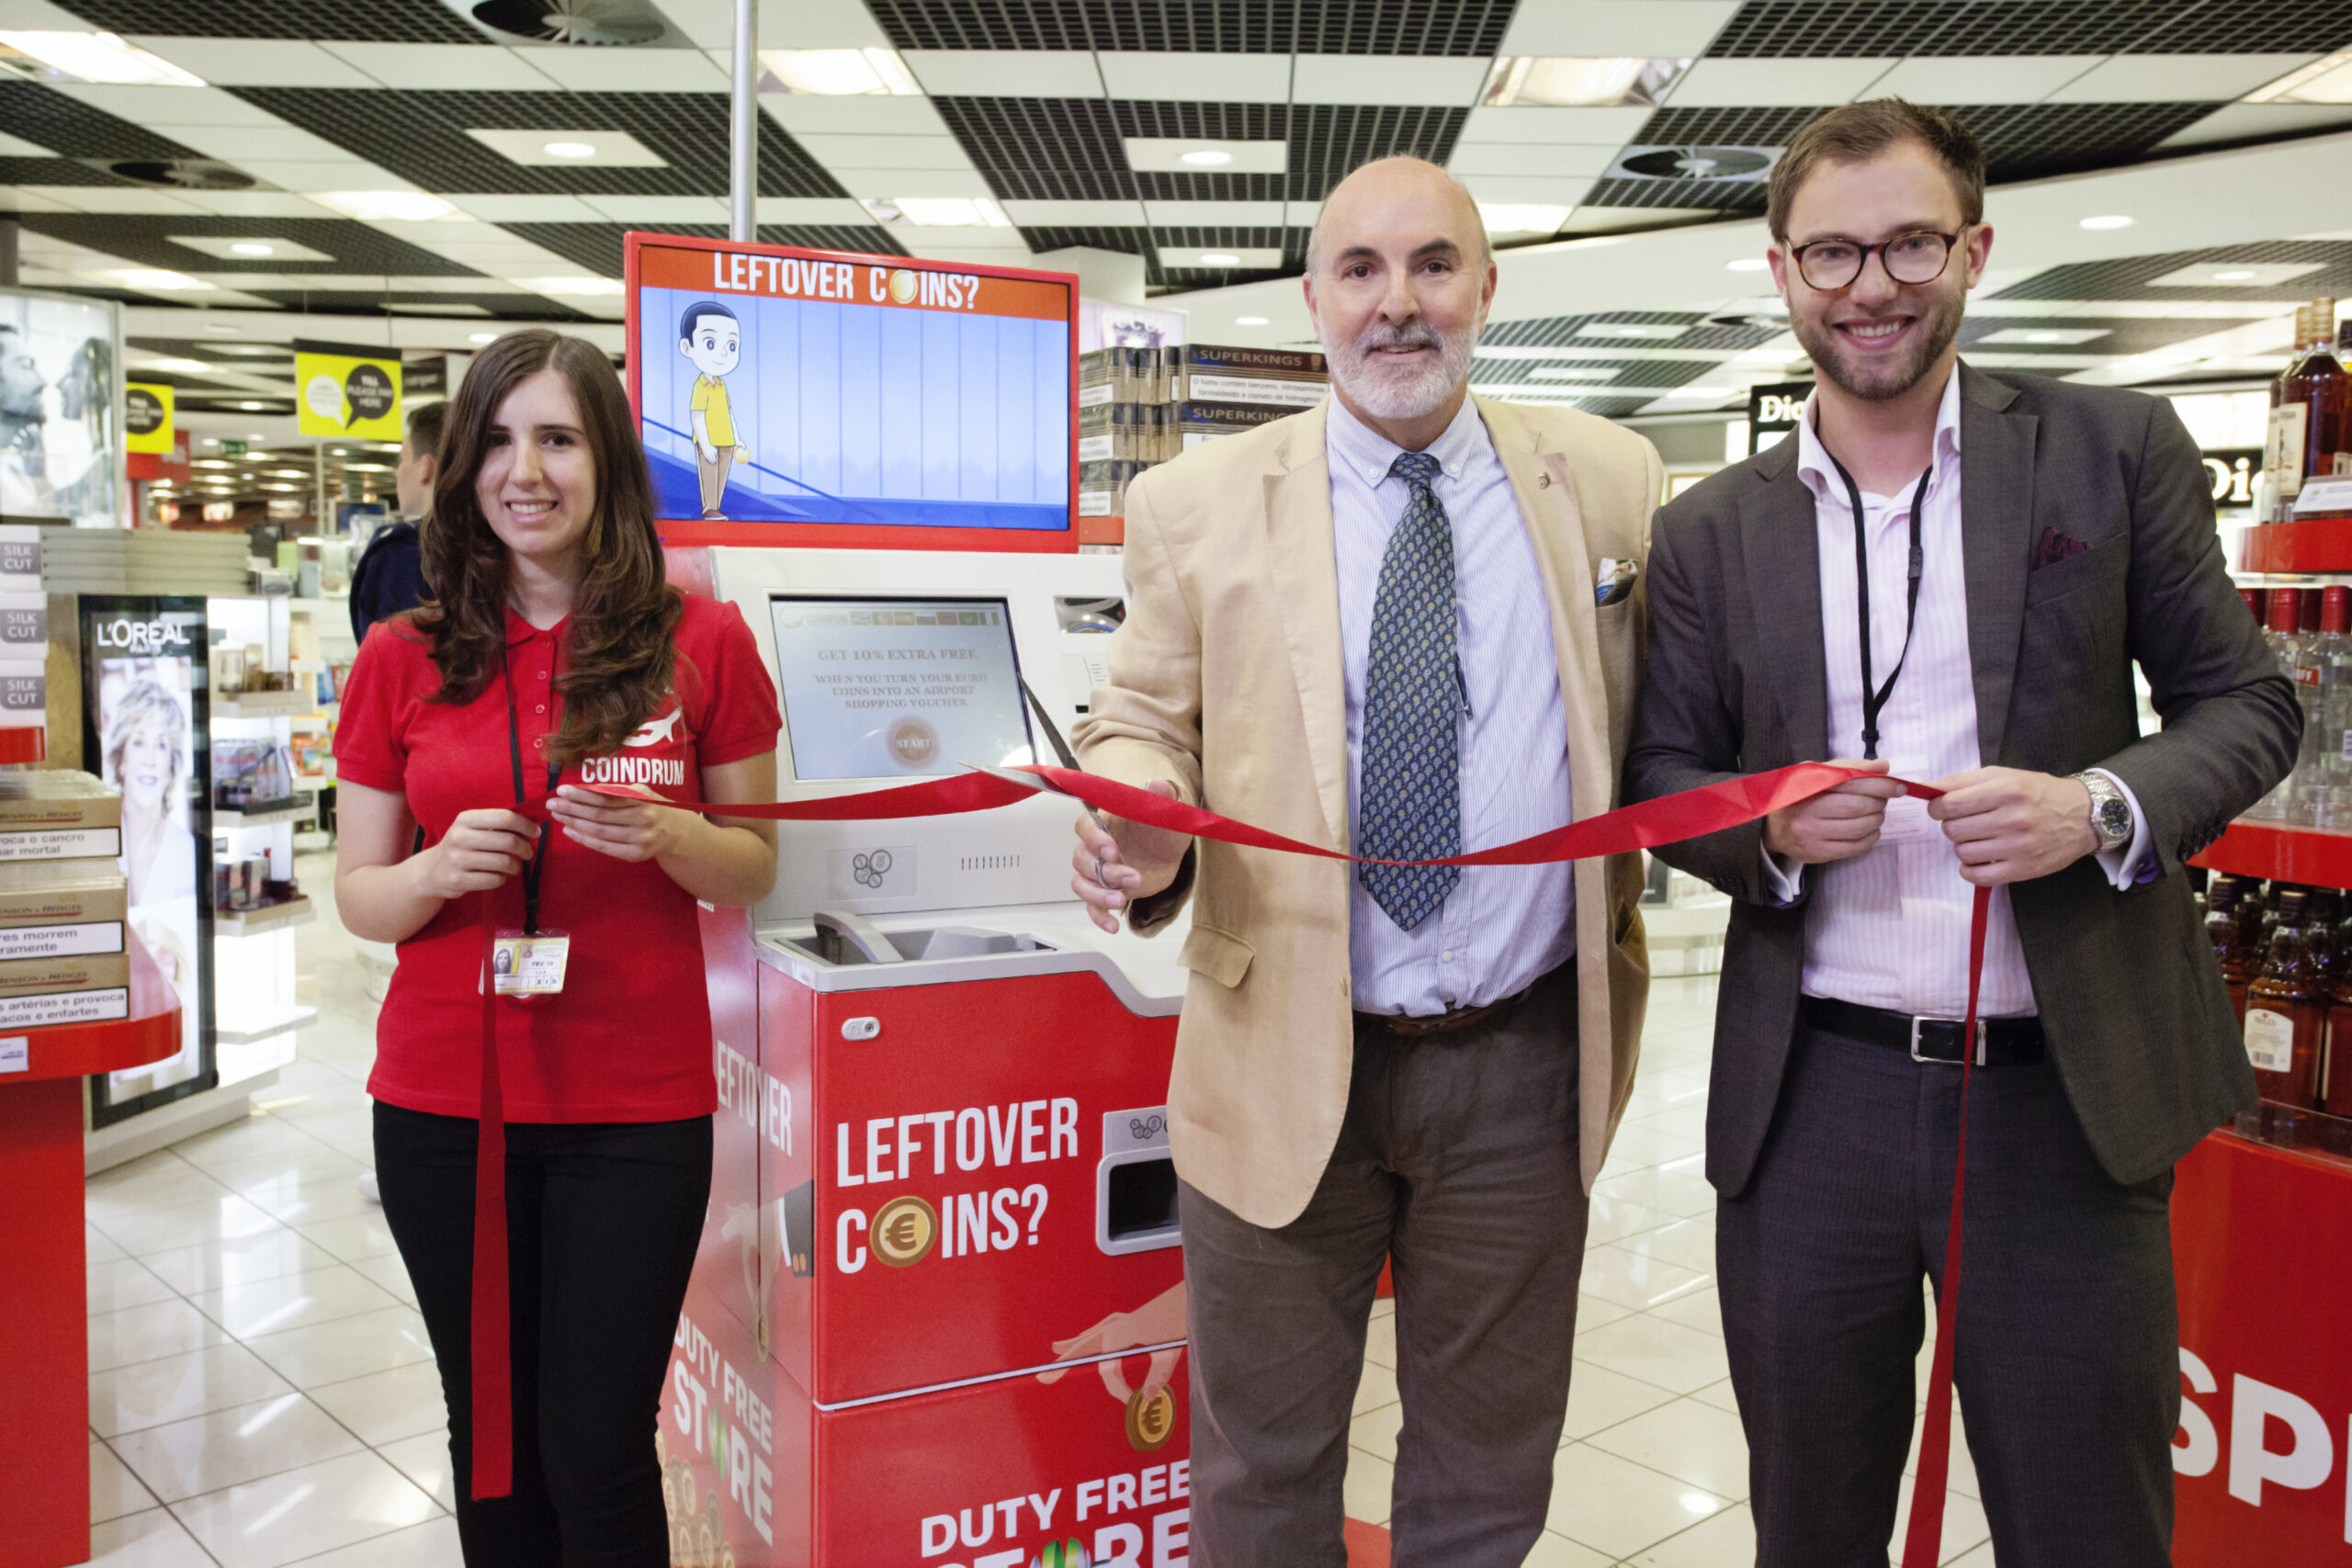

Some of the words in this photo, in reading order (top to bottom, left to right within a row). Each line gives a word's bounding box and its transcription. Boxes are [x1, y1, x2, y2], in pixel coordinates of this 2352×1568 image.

[714, 252, 854, 299] LEFTOVER
[1199, 350, 1302, 367] SUPERKINGS
[4, 545, 32, 557] SILK
[4, 558, 33, 570] CUT
[7, 612, 37, 624] SILK
[7, 626, 37, 637] CUT
[818, 649, 848, 660] GET
[854, 649, 884, 660] 10%
[888, 649, 936, 660] EXTRA
[941, 649, 978, 660] FREE
[815, 674, 853, 683] WHEN
[856, 674, 883, 683] YOU
[885, 674, 917, 683] TURN
[920, 674, 953, 683] YOUR
[956, 673, 988, 682] EURO
[7, 679, 37, 691] SILK
[832, 687, 869, 696] COINS
[873, 686, 902, 696] INTO
[905, 686, 921, 695] AN
[924, 685, 975, 695] AIRPORT
[7, 693, 37, 705] CUT
[844, 700, 908, 709] SHOPPING
[910, 698, 967, 708] VOUCHER
[897, 738, 931, 749] START
[582, 756, 684, 786] COINDRUM
[41, 833, 85, 843] cancro
[19, 845, 61, 855] mortal
[23, 930, 78, 941] morrem
[8, 998, 58, 1011] artérias
[74, 993, 124, 1007] provoca
[47, 1007, 99, 1020] enfartes
[718, 1040, 792, 1157] EFTOVER
[837, 1097, 1079, 1188] LEFTOVER
[724, 1359, 773, 1456] FREE
[2170, 1346, 2352, 1545] SP
[922, 1488, 1063, 1559] DUTY
[1077, 1459, 1191, 1522] FREE
